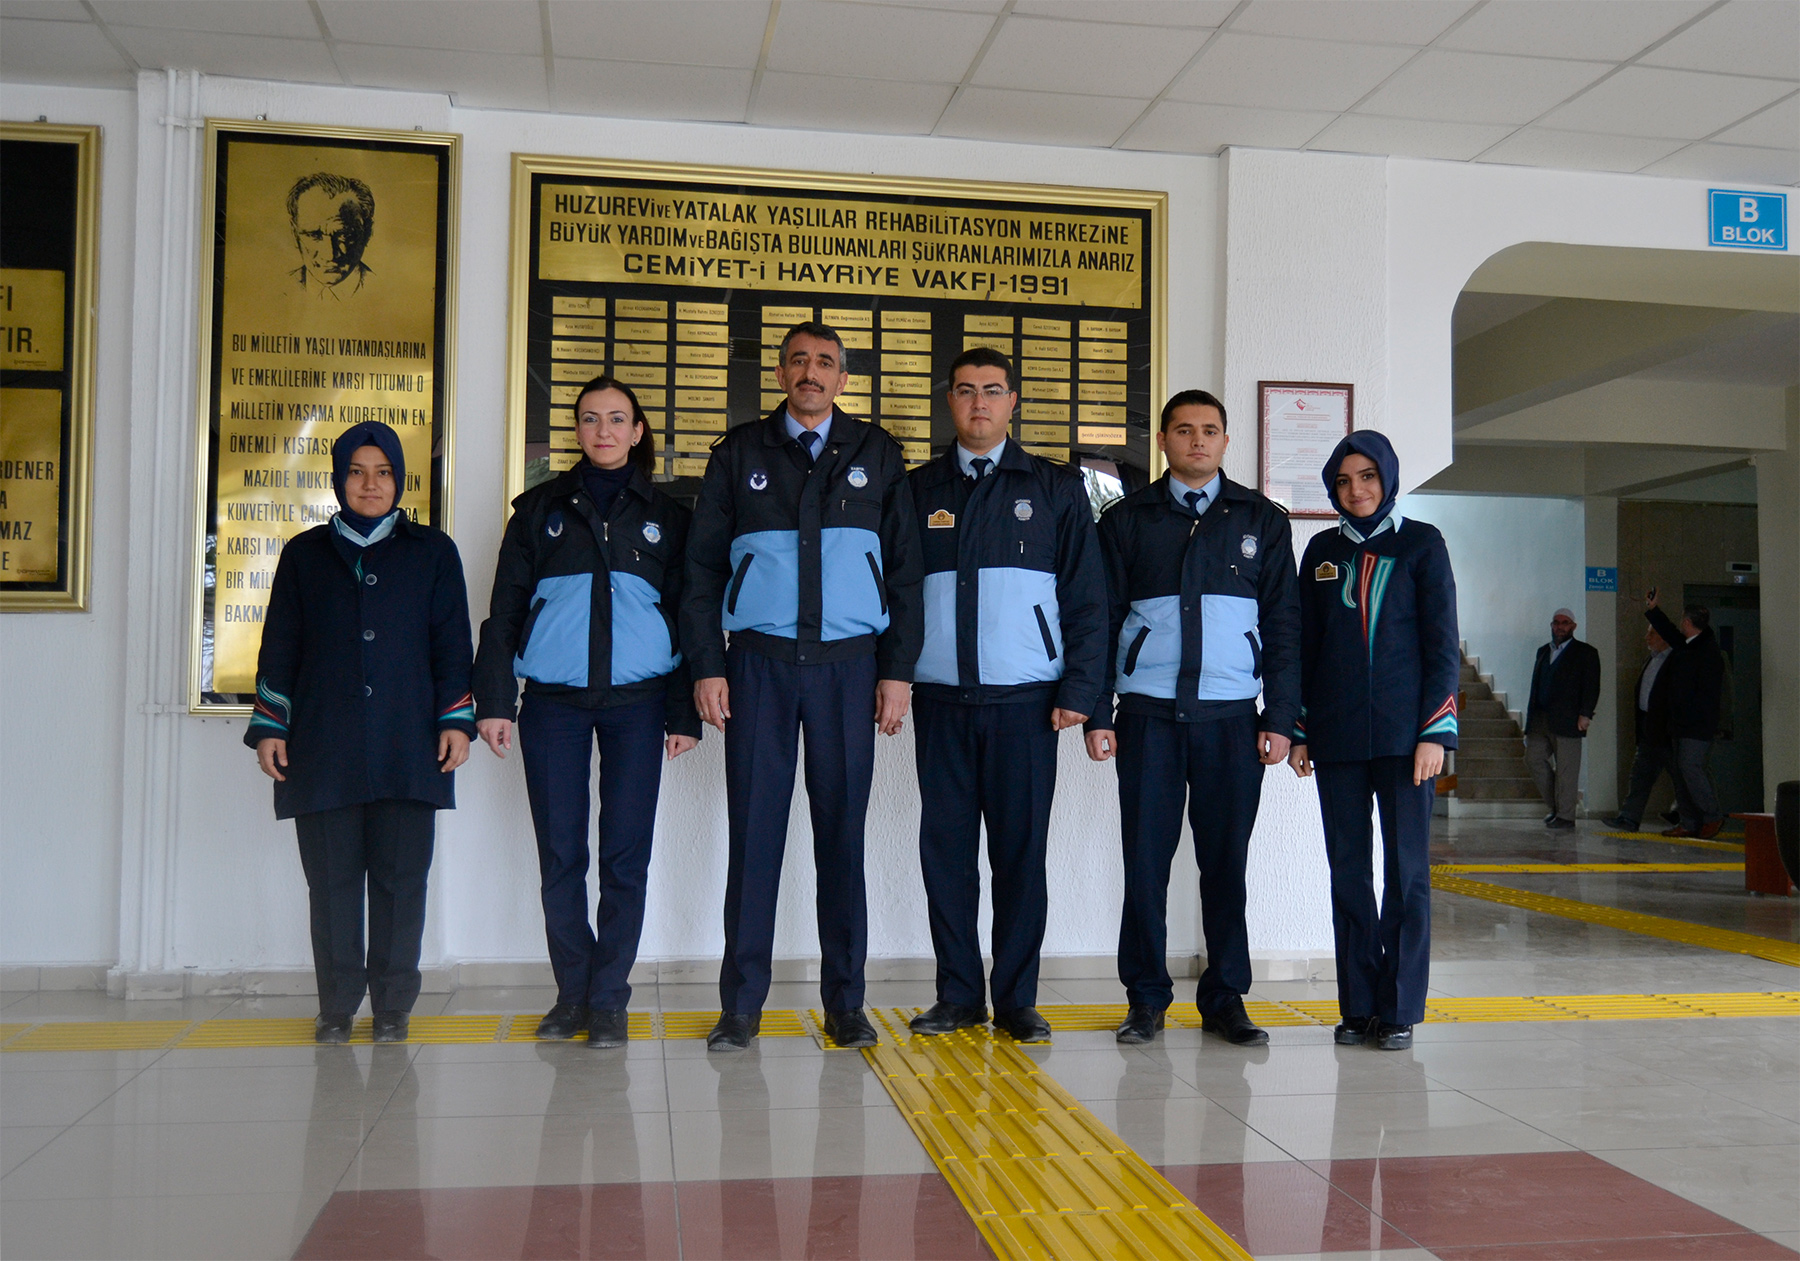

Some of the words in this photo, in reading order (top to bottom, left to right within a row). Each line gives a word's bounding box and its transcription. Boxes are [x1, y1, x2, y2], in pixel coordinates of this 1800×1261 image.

[672, 199, 757, 224] YATALAK
[767, 205, 857, 229] YAŞLILAR
[1739, 197, 1759, 223] B
[1722, 226, 1775, 243] BLOK
[550, 222, 611, 243] BÜYÜK
[617, 225, 687, 247] YARDIM
[706, 228, 782, 255] BAĞIŞTA
[788, 234, 907, 260] BULUNANLARI
[912, 241, 1071, 268] ŞÜKRANLARIMIZLA
[1077, 250, 1135, 272] ANARIZ
[912, 268, 1068, 296] VAKFI-1991
[232, 334, 246, 351] BU
[251, 332, 300, 354] MİLLETİN
[305, 337, 335, 357] YAŞLI
[339, 338, 426, 360] VATANDAŞLARINA
[232, 368, 245, 385] VE
[249, 366, 327, 388] EMEKLİLERİNE
[332, 372, 365, 392] KARŞI
[369, 373, 412, 392] TUTUMU
[230, 400, 283, 421] MİLLETİN
[287, 404, 334, 424] YAŞAMA
[412, 408, 426, 426] EN
[229, 432, 276, 454] ÖNEMLİ
[0, 460, 54, 480] DENER
[243, 467, 290, 488] MAZİDE
[227, 501, 294, 522] KUVVETİYLE
[227, 537, 261, 558] KARŞI
[226, 568, 244, 589] BİR
[1597, 569, 1607, 577] B
